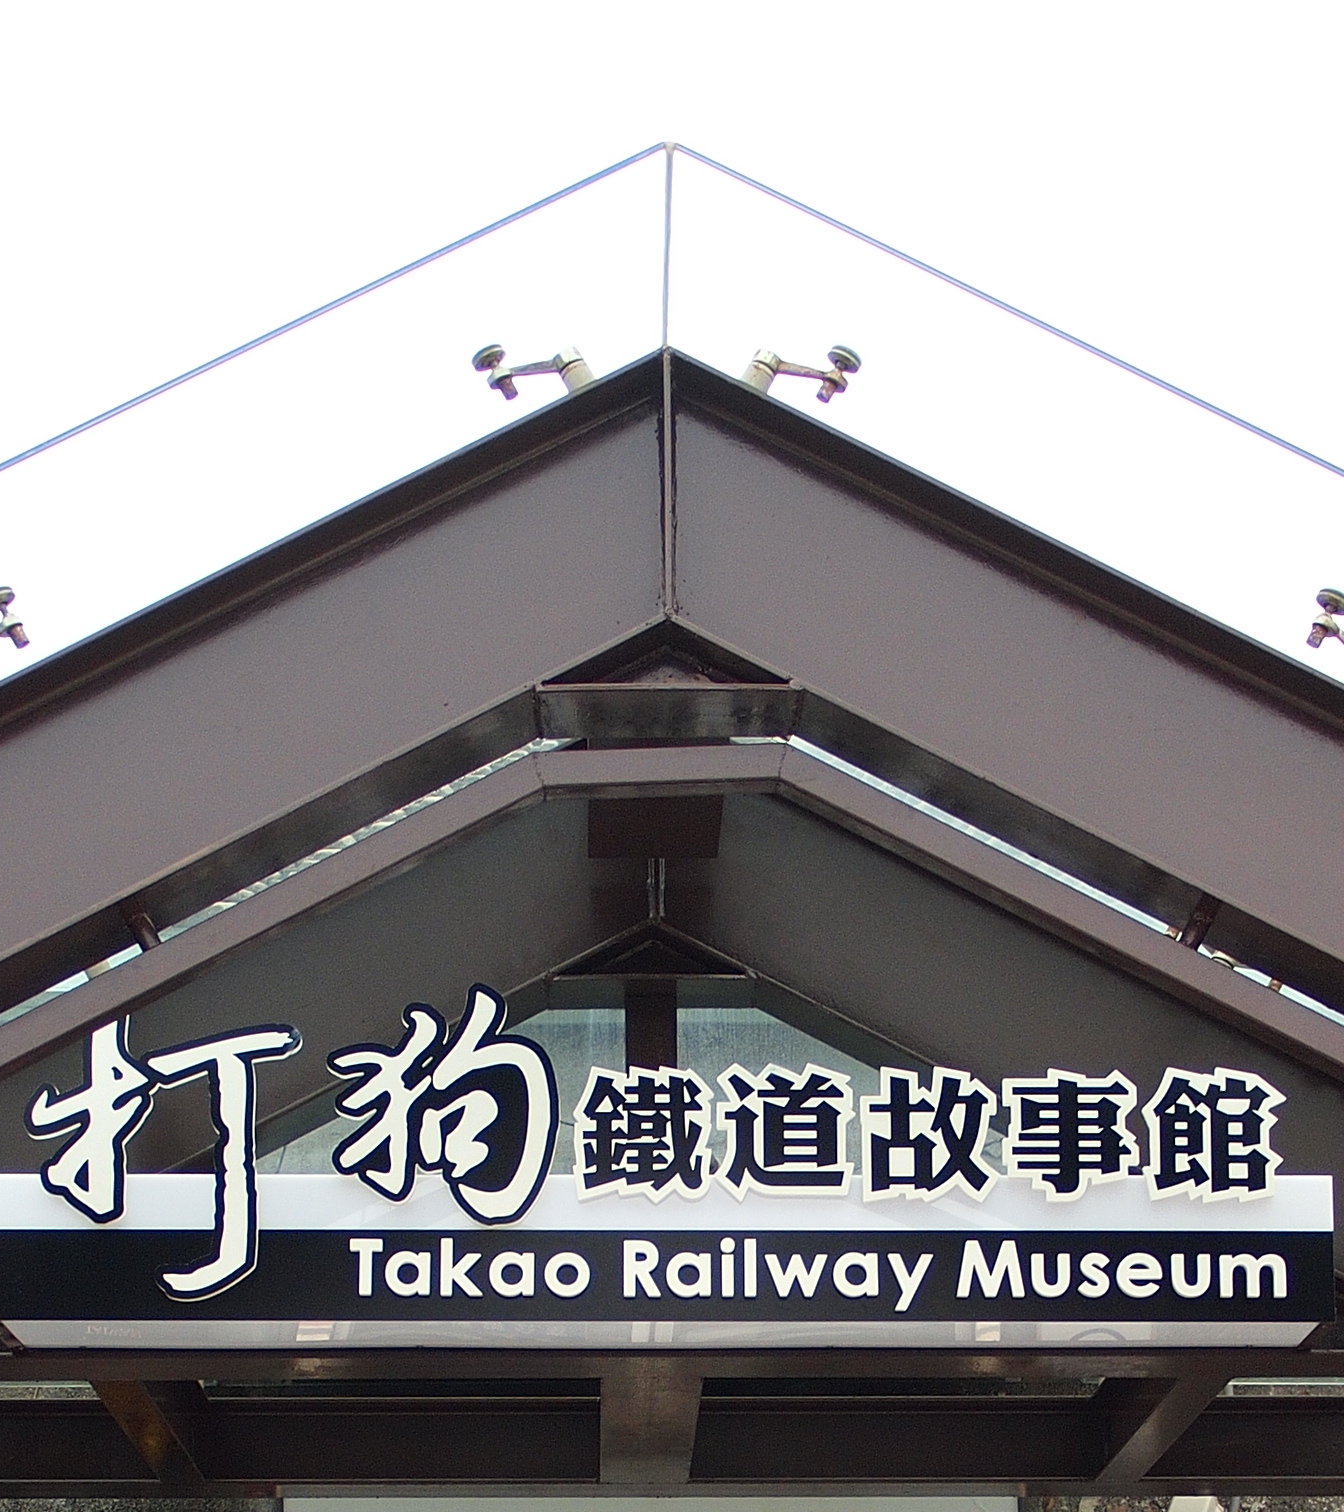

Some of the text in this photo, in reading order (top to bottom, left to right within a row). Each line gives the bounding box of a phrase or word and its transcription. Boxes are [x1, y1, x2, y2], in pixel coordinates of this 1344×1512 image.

[25, 984, 1285, 1302] 打狗鐵道故事館
[349, 1237, 1288, 1312] Takao Railway Museum
